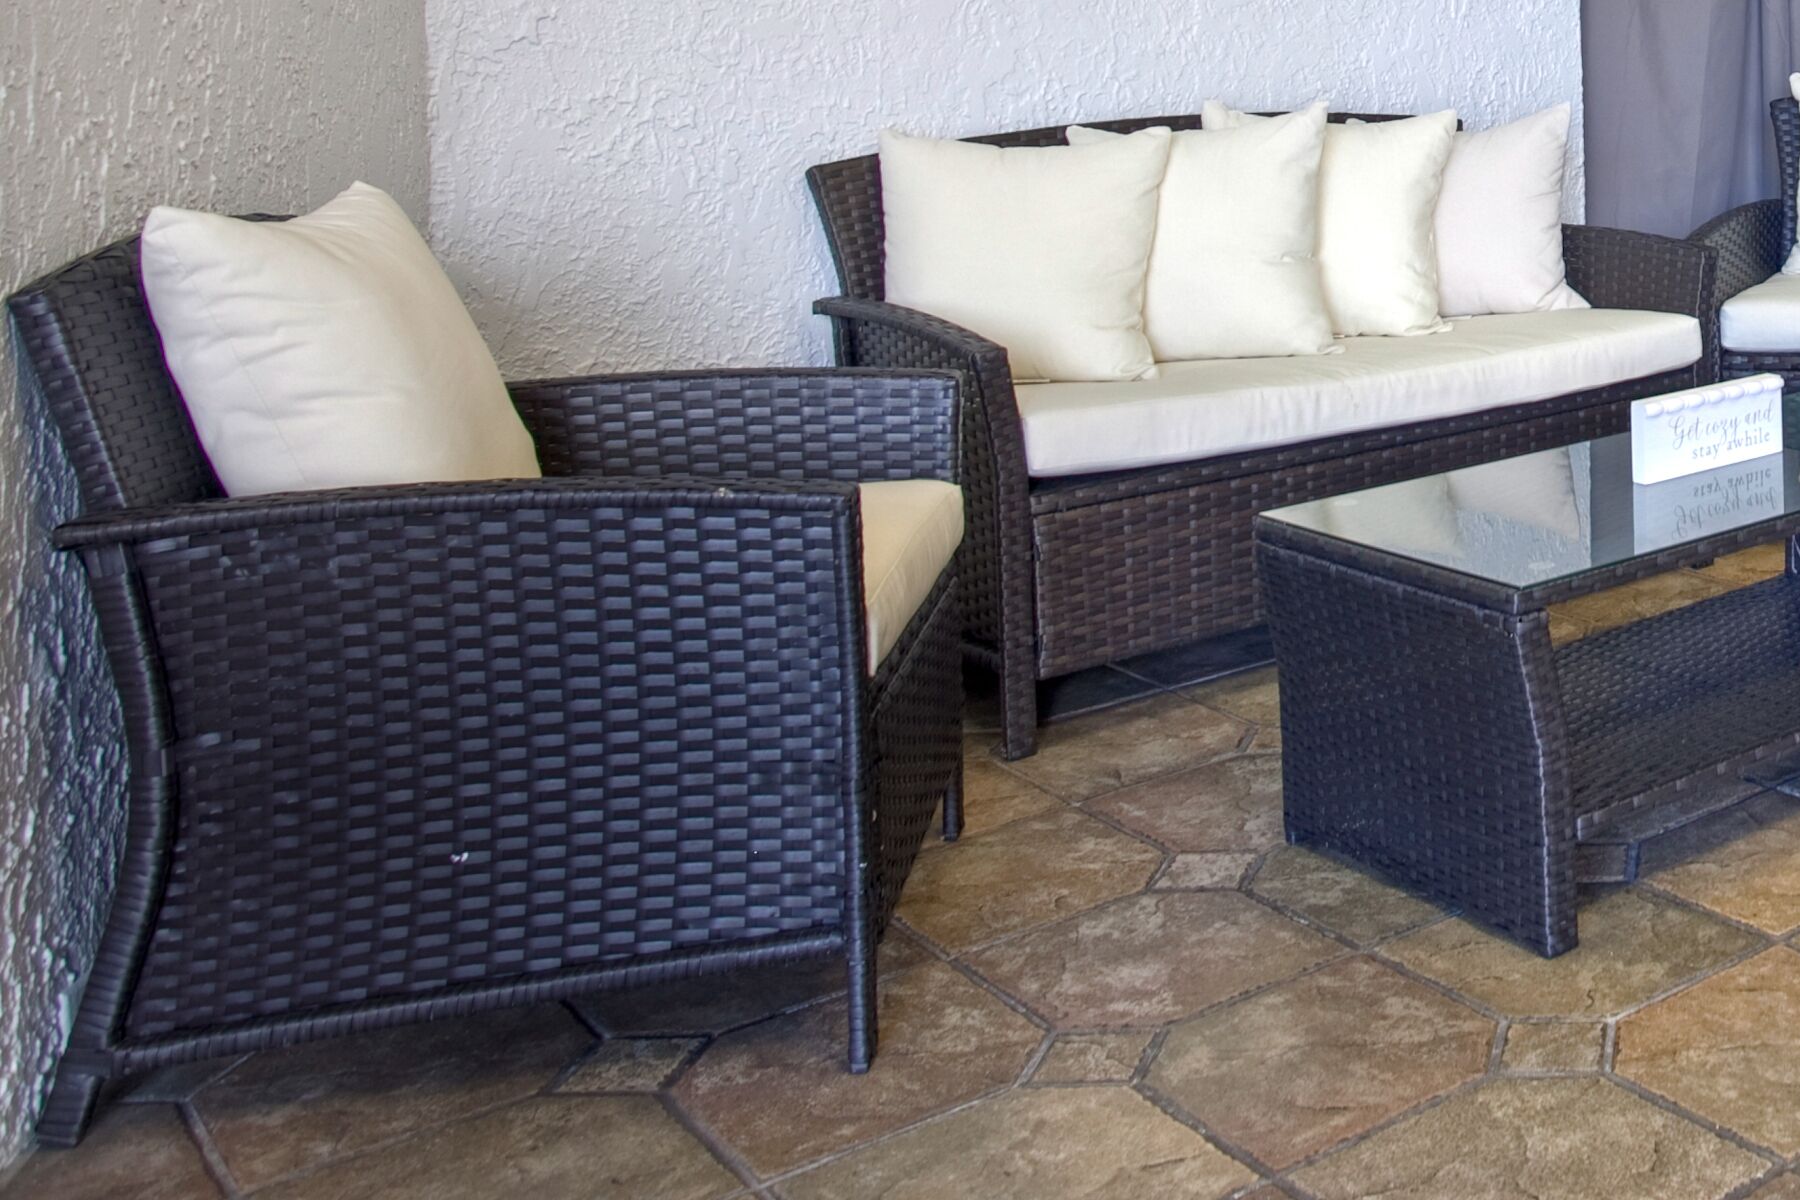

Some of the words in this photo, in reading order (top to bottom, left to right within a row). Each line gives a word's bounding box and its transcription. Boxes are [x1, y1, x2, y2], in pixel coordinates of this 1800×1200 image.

[1669, 415, 1704, 450] Get
[1704, 416, 1741, 445] cozy
[1744, 399, 1775, 425] and
[1692, 441, 1721, 460] stay
[1726, 427, 1771, 451] awhile
